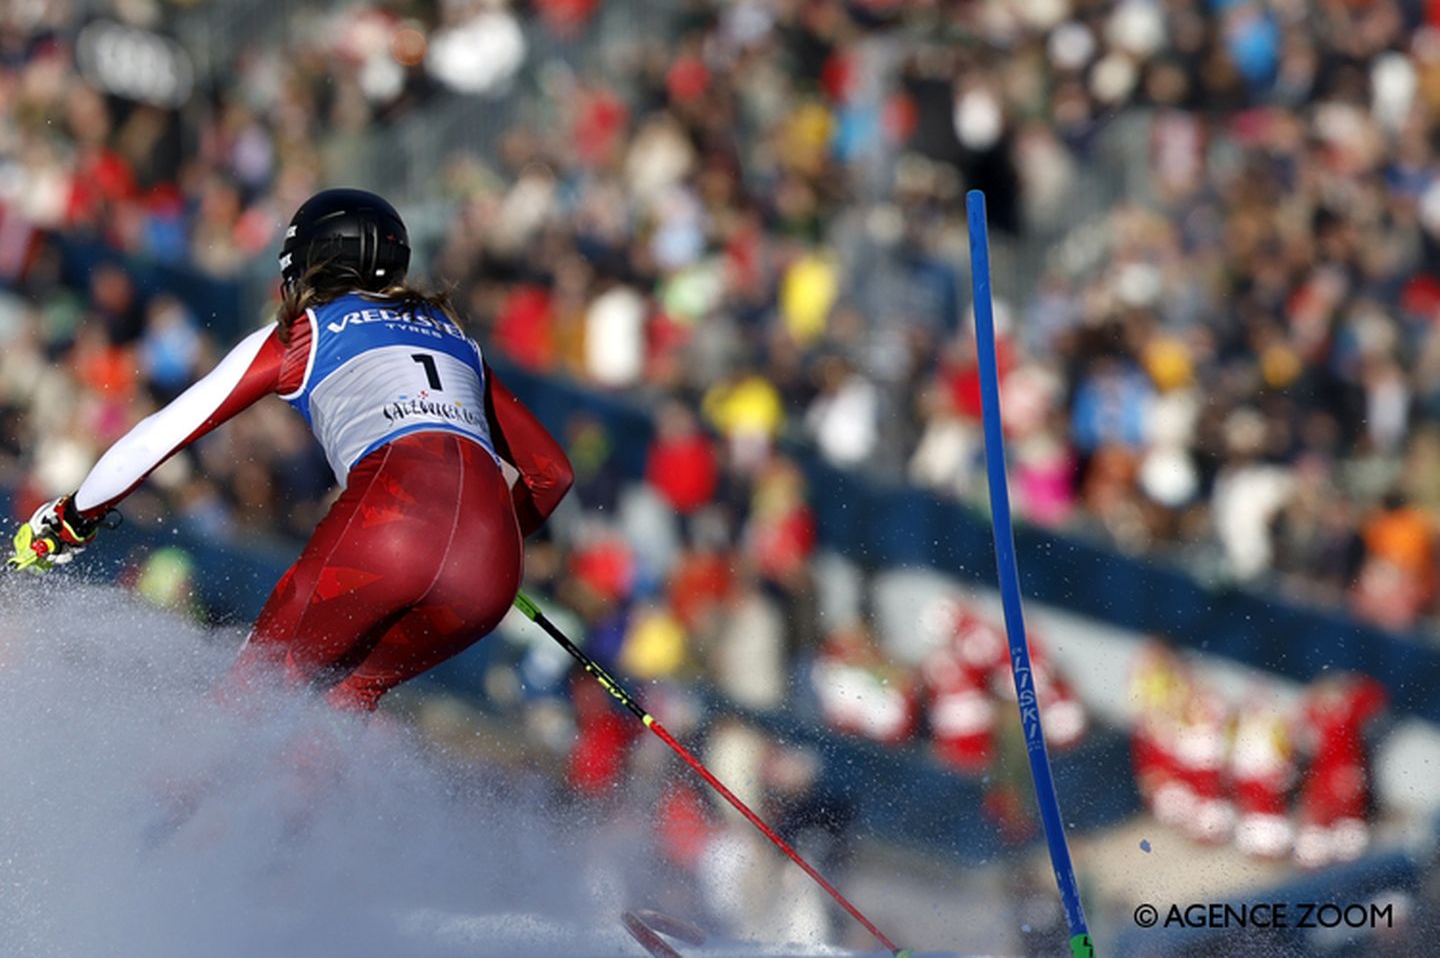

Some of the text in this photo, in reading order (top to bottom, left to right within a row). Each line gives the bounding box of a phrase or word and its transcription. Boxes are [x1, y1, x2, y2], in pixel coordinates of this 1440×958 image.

[385, 322, 443, 339] TYRES
[410, 353, 443, 392] 1
[1014, 656, 1037, 740] LISKI
